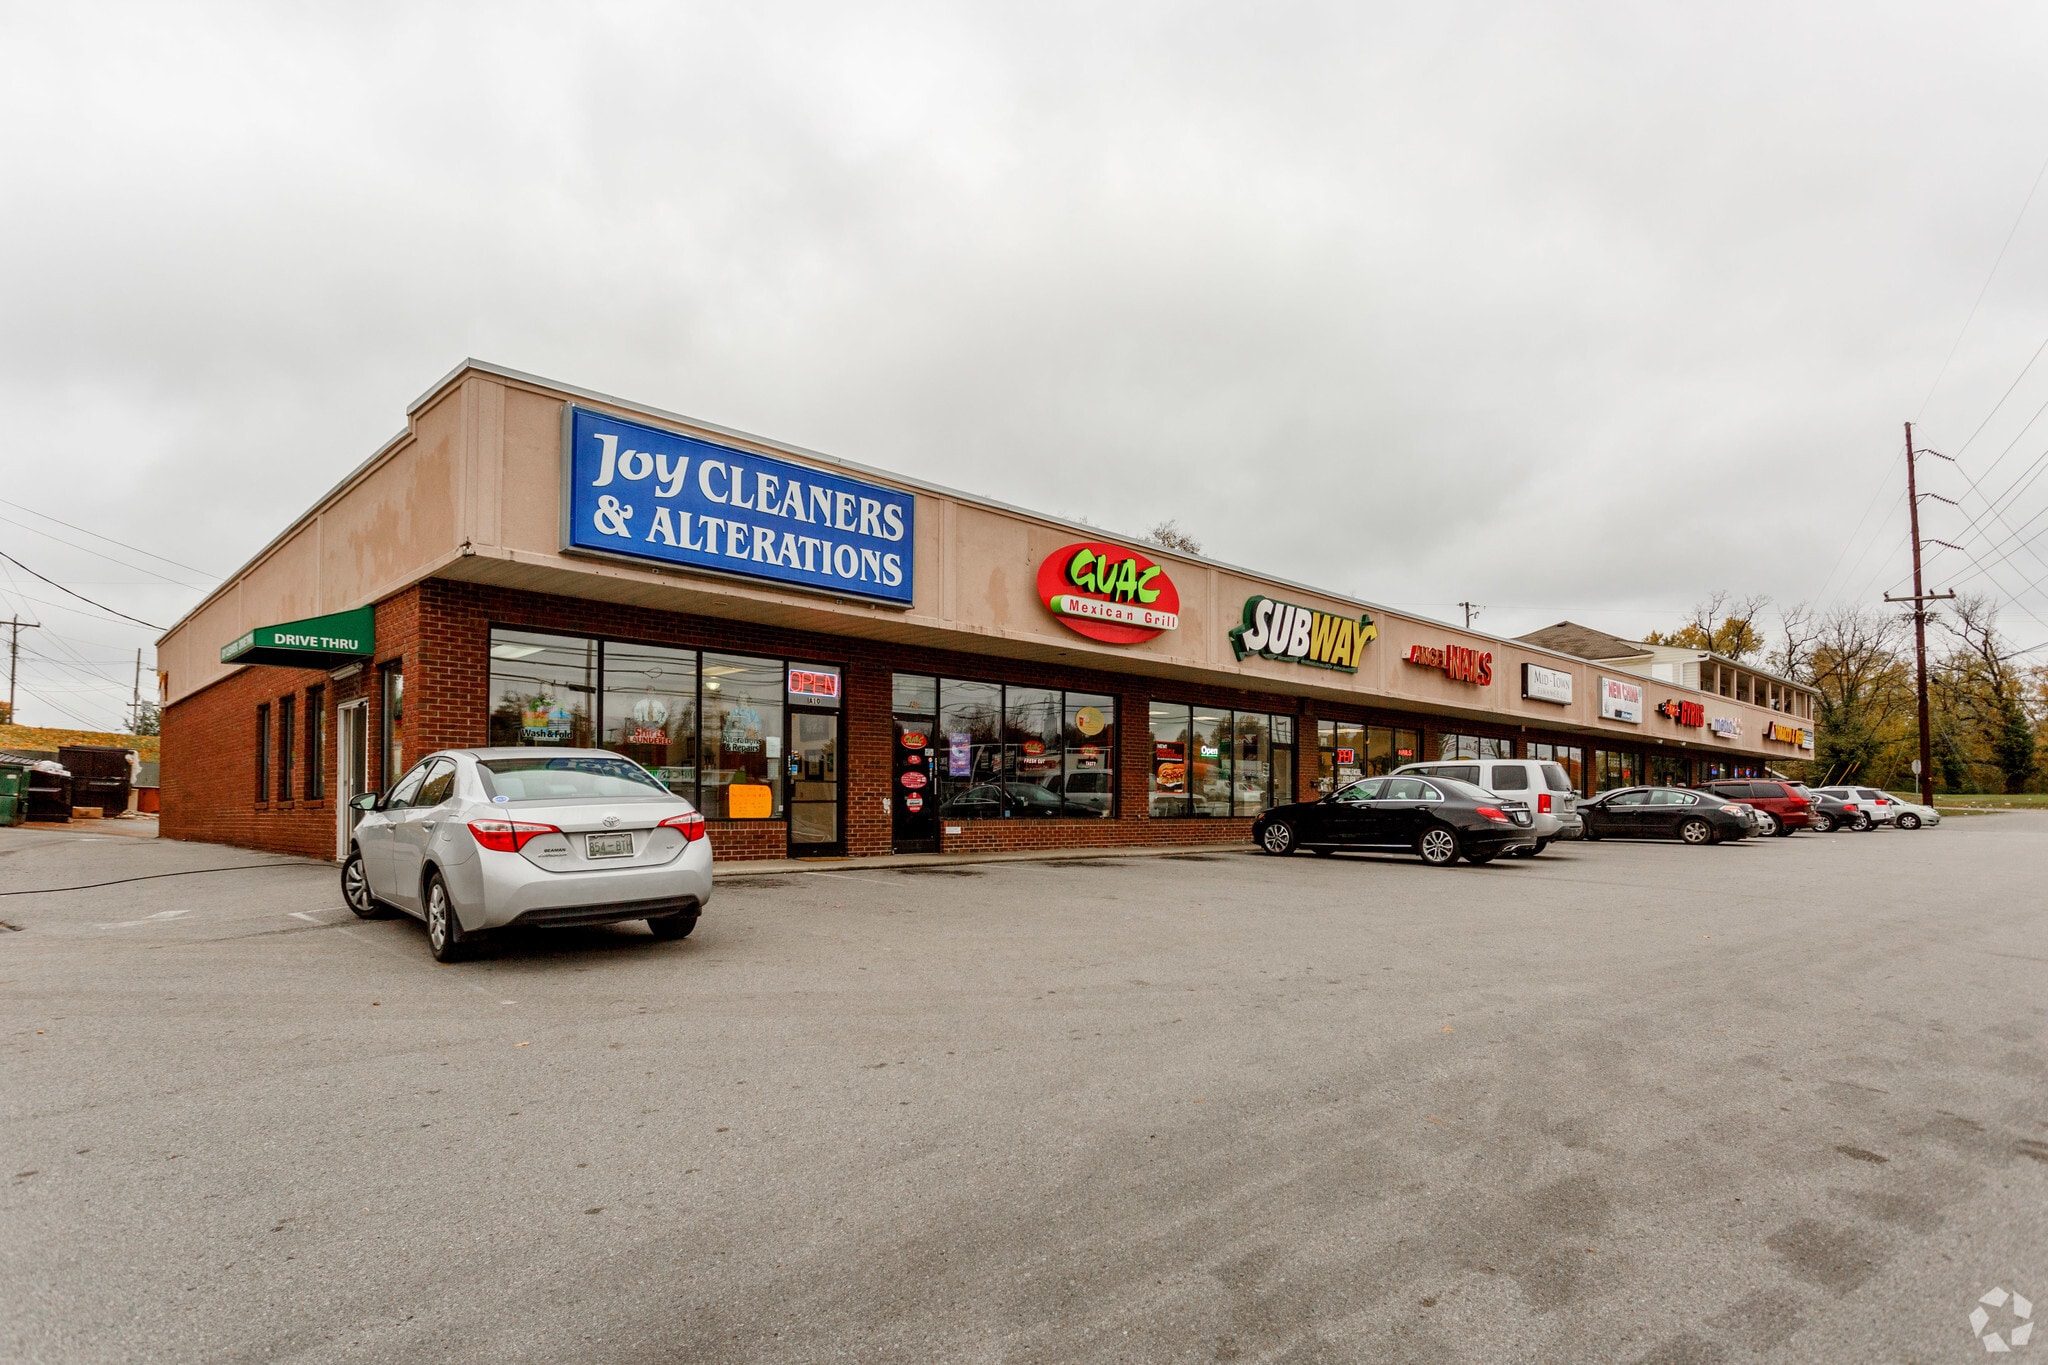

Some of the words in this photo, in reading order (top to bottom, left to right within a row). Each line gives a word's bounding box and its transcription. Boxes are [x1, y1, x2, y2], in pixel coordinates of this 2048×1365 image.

[698, 460, 905, 542] CLEANERS
[593, 494, 634, 539] &
[645, 506, 903, 588] ALTERATIONS
[1070, 548, 1162, 604] GUAC
[1069, 598, 1134, 621] Mexican
[1144, 611, 1176, 628] Grill
[274, 633, 319, 647] DRIVE
[320, 636, 359, 650] THRU
[1242, 599, 1378, 668] SUBWAY
[1446, 645, 1493, 686] NAILS
[790, 671, 837, 697] OPEN
[1681, 700, 1705, 728] GYROS
[522, 728, 546, 738] Wash
[547, 730, 554, 738] &
[555, 730, 573, 739] Fold
[627, 736, 673, 745] LAUNDERED
[634, 727, 665, 738] Shirts
[733, 744, 759, 754] Repairs
[1201, 745, 1218, 756] Open
